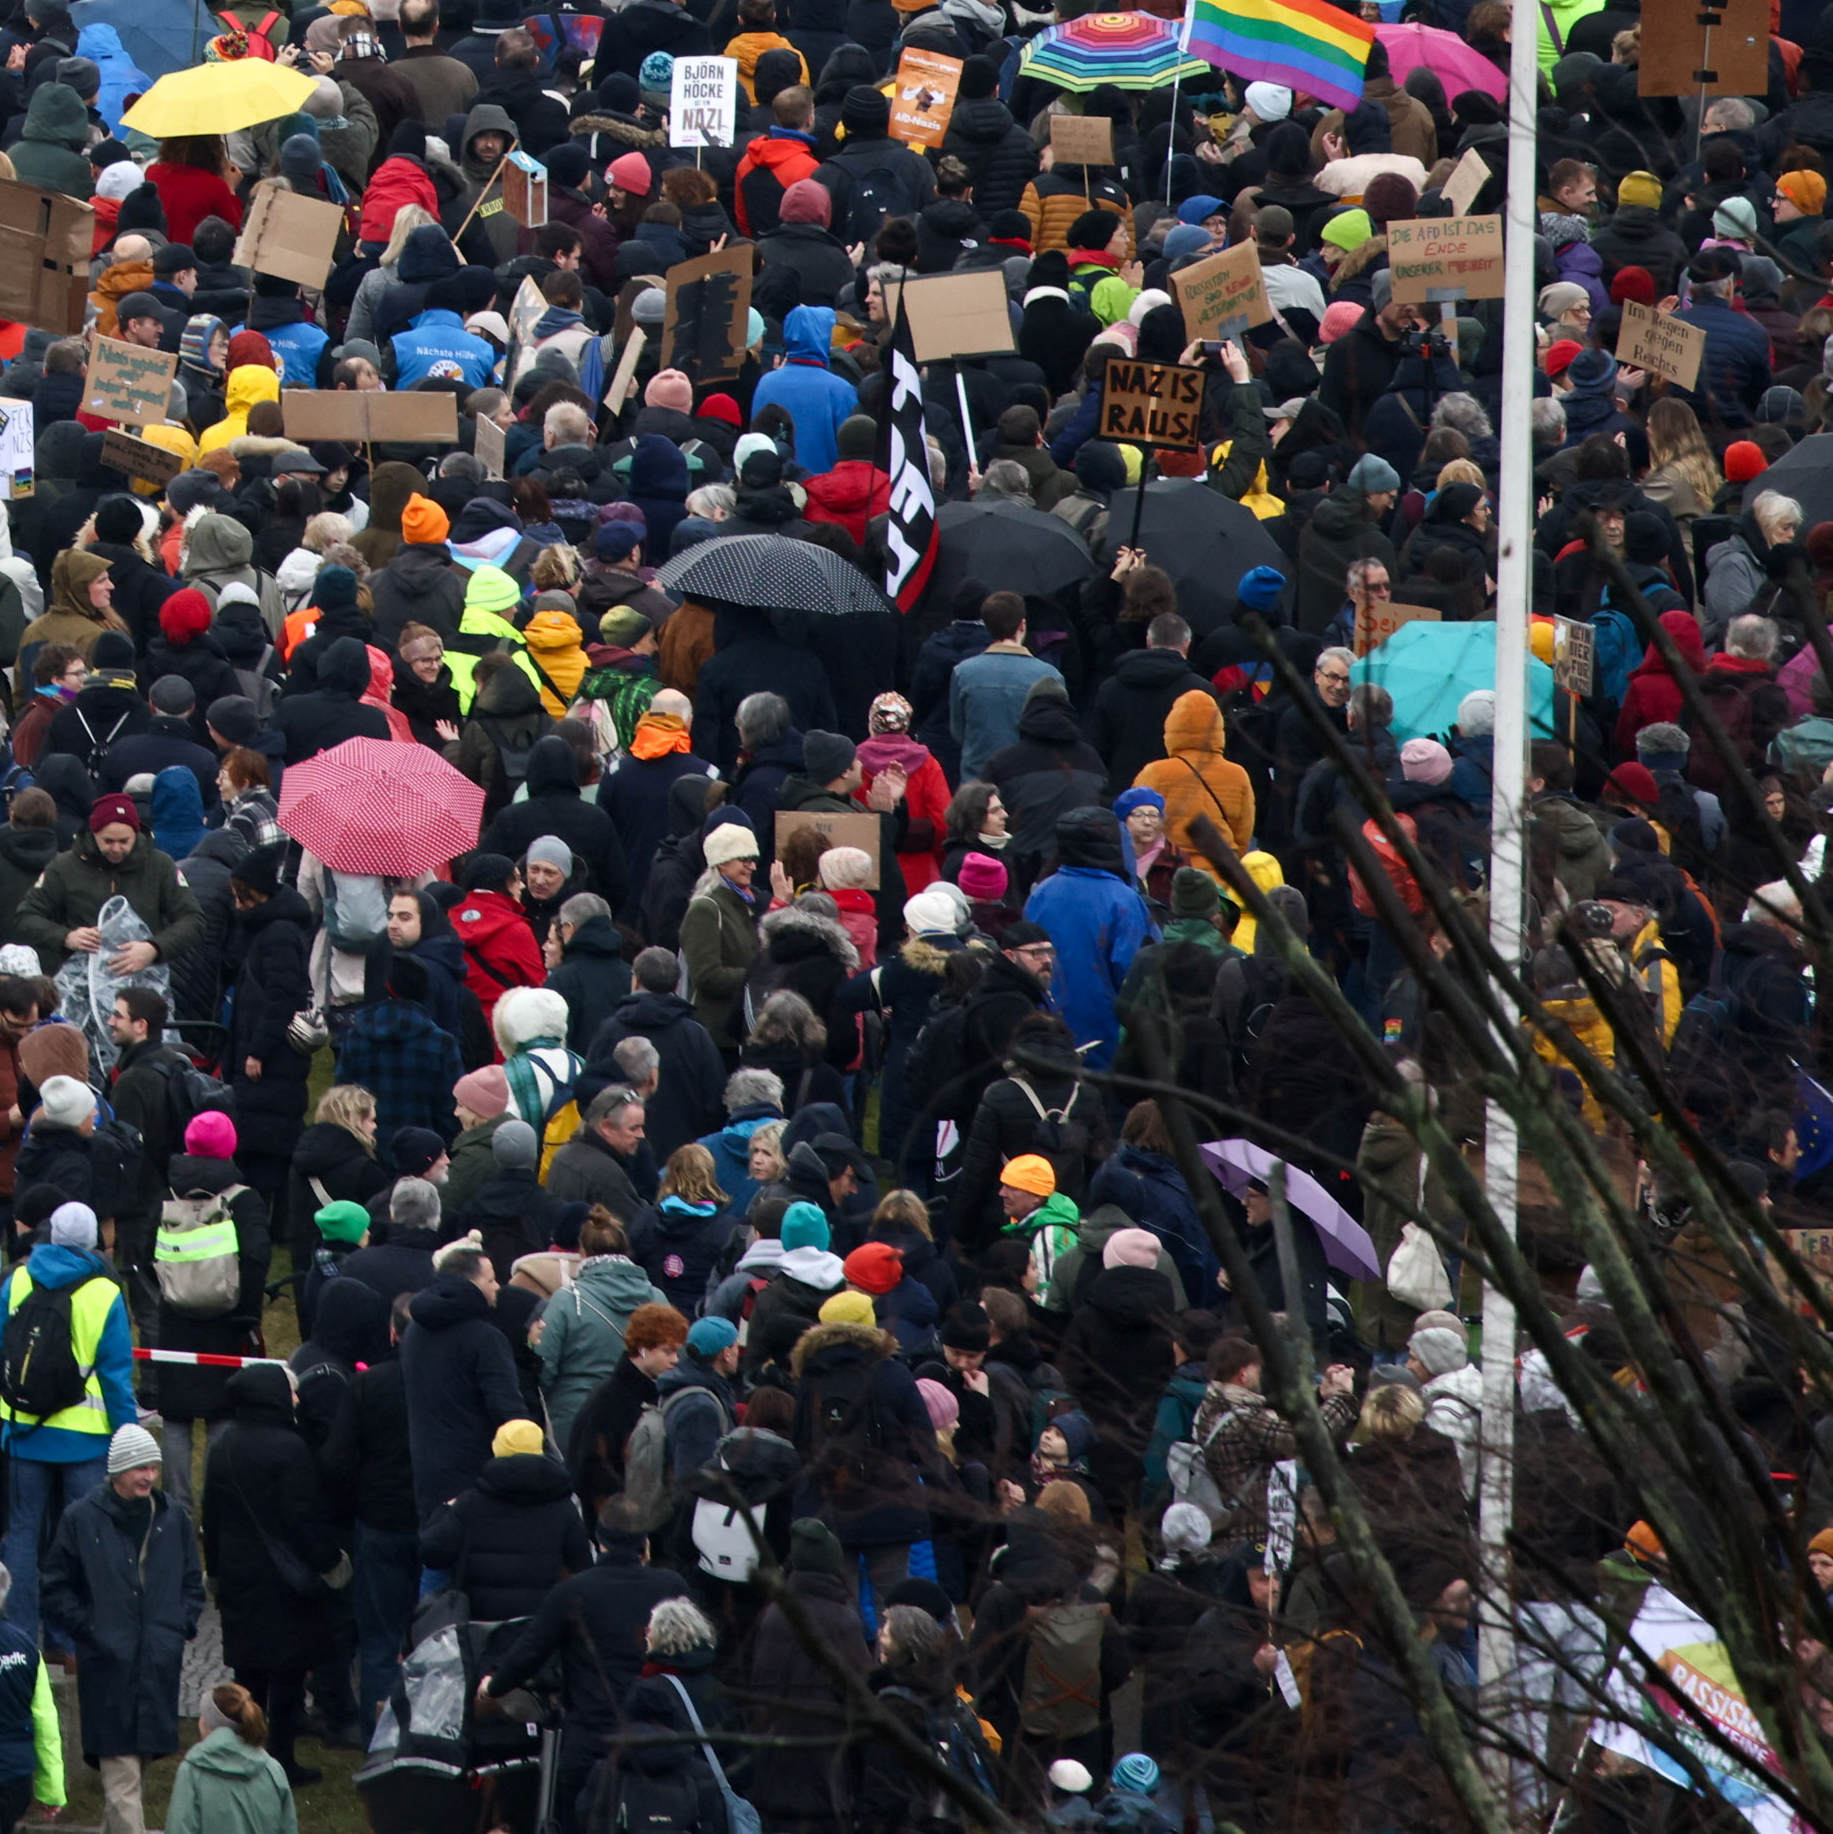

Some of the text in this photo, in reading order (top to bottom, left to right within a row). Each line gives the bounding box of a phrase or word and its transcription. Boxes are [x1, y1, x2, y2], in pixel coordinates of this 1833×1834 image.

[684, 60, 725, 81] BJÖRN
[683, 77, 724, 100] HÖCKE
[682, 106, 723, 132] NAZI
[894, 112, 942, 132] AfD-Nazis
[1390, 219, 1496, 245] DIE AFD IST DAS
[1424, 241, 1469, 257] ENDE
[1626, 302, 1646, 319] Im
[416, 346, 454, 357] Nächste
[1643, 329, 1684, 357] gegen
[1632, 344, 1679, 378] Rechts
[1108, 364, 1199, 405] NAZIS
[1108, 403, 1199, 447] RAUS!
[2, 1651, 27, 1668] adfc
